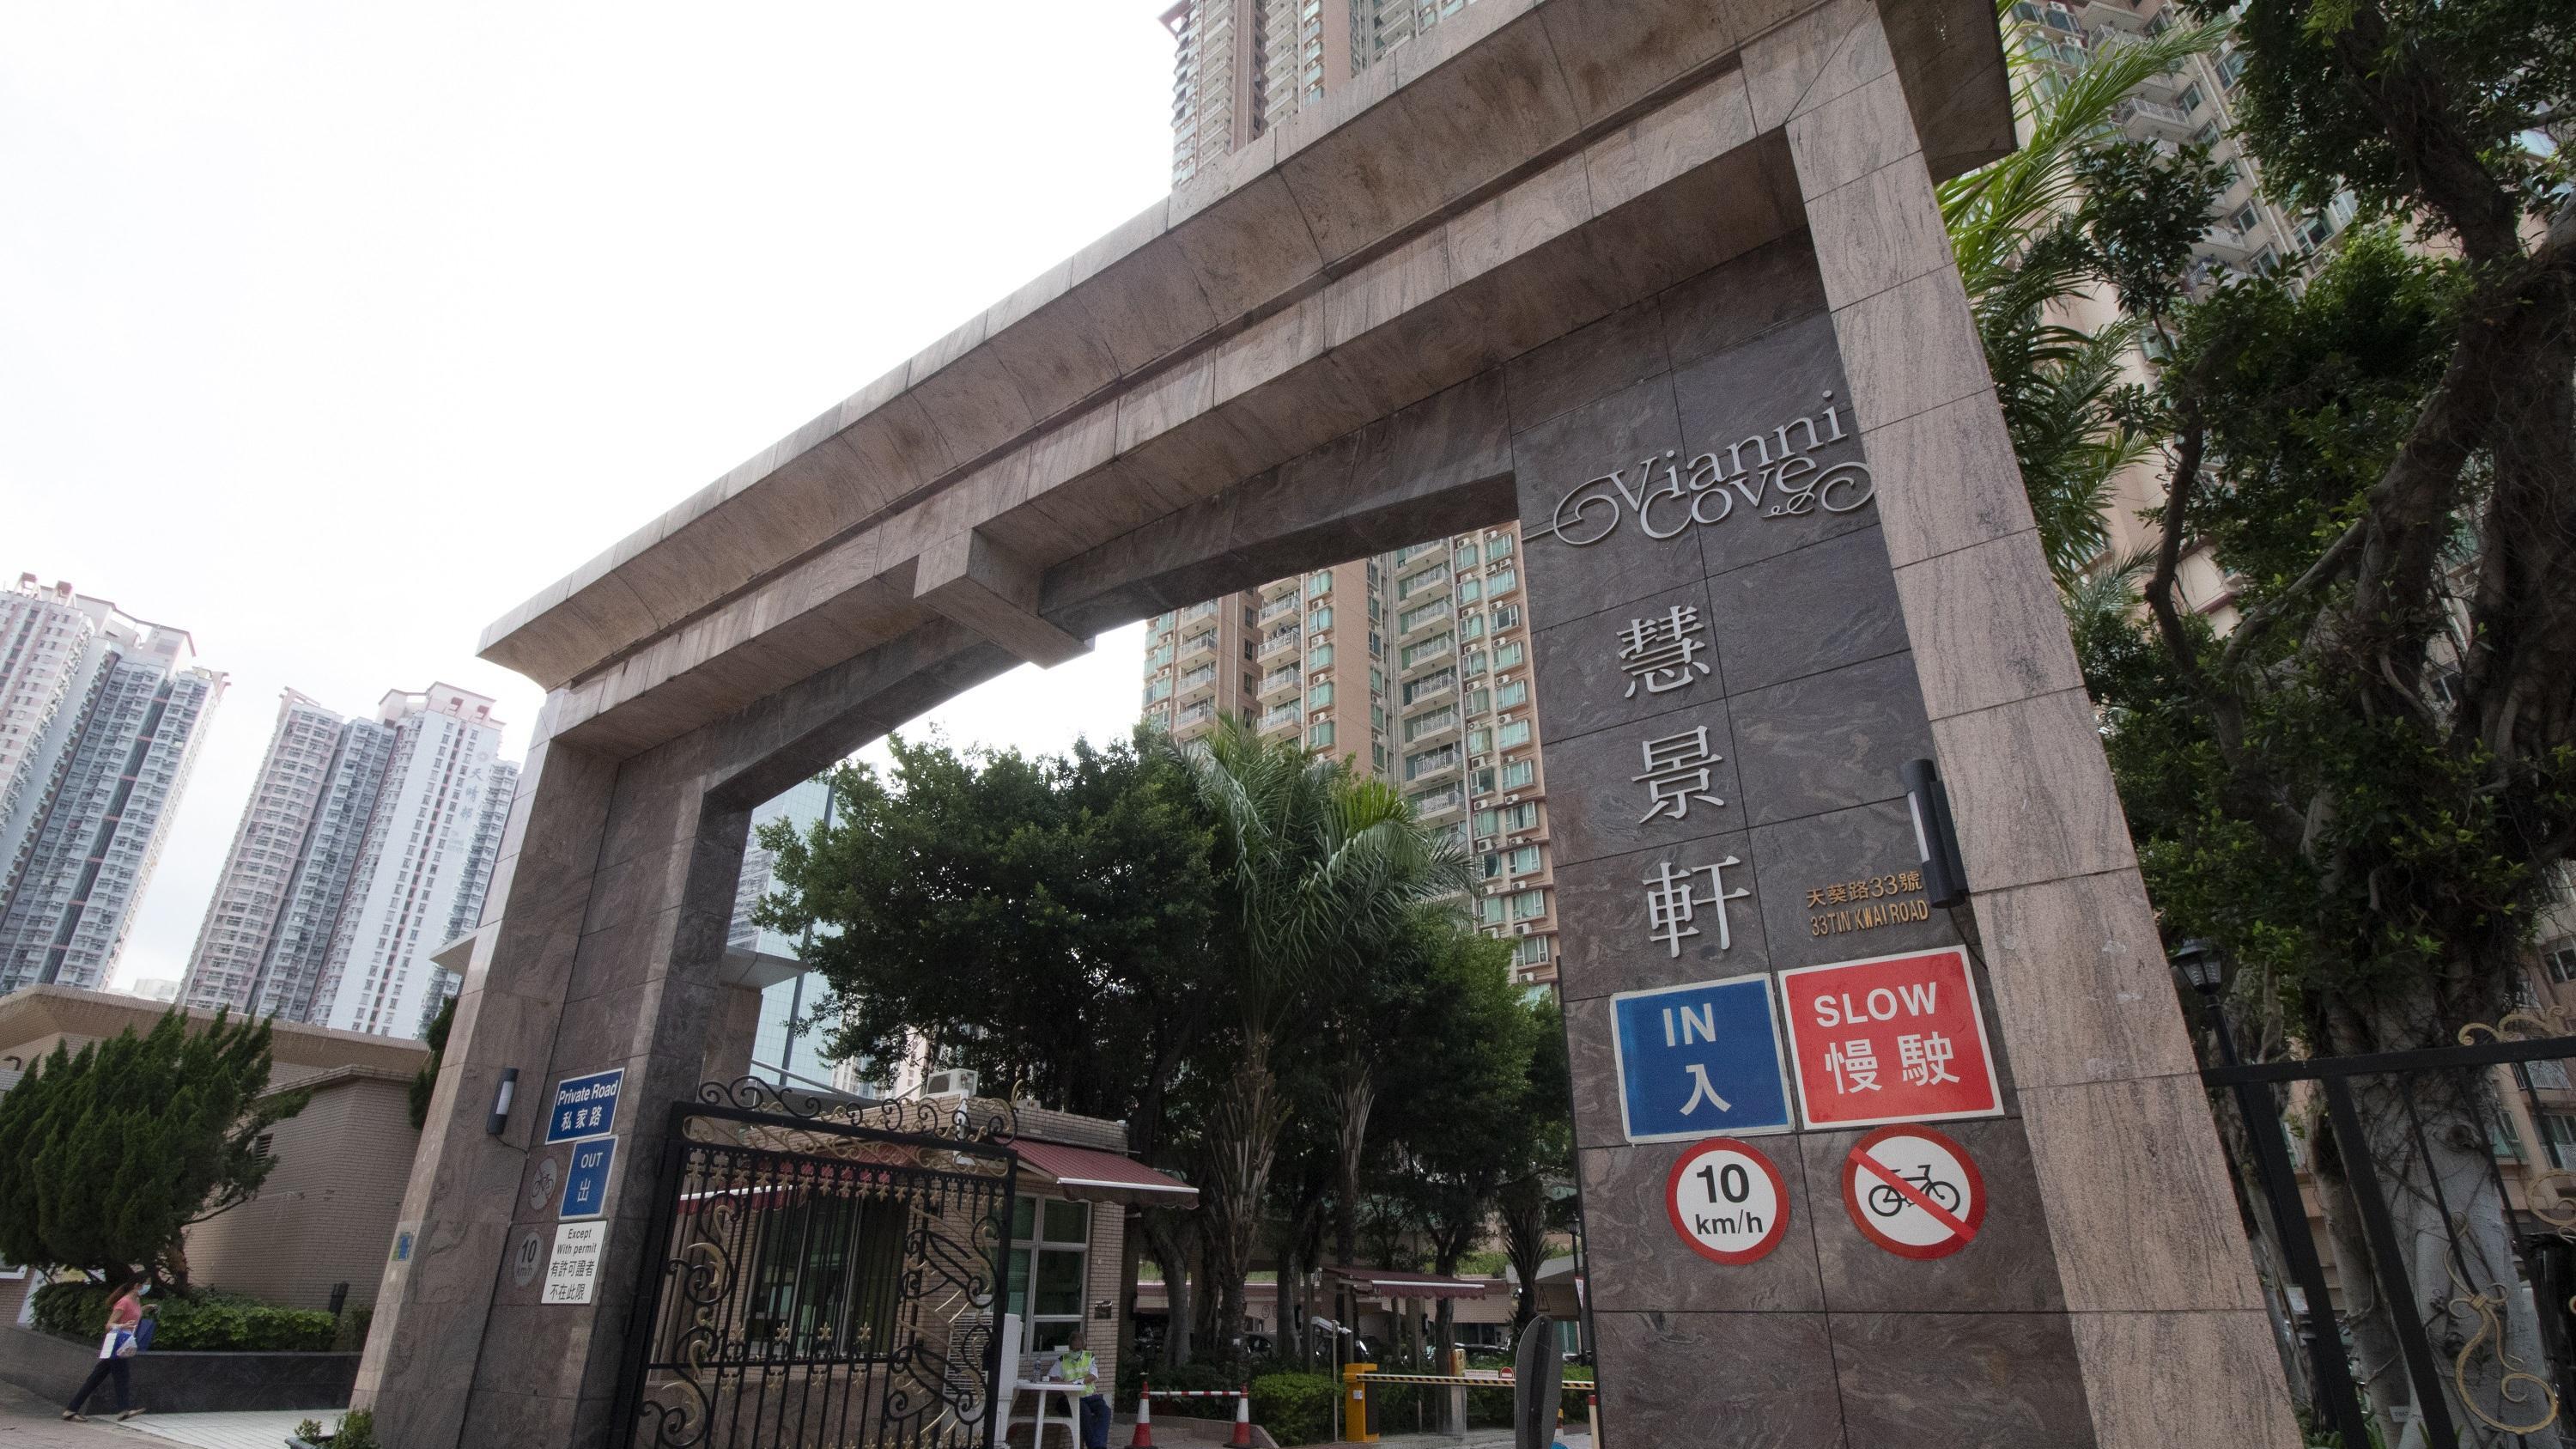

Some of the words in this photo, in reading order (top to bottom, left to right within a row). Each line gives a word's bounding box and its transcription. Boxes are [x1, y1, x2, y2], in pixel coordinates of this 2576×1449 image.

[1553, 390, 1848, 545] Vianni
[1640, 456, 1875, 539] Cove
[1616, 606, 1751, 959] 慧景軒
[1806, 870, 1923, 909] 天葵路33號
[1854, 904, 1888, 930] KWAI
[1889, 899, 1929, 925] ROAD
[1814, 981, 1937, 1028] SLOW
[1662, 1002, 1716, 1047] IN
[1824, 1031, 1960, 1095] 慢駛
[557, 1087, 591, 1106] Private
[591, 1079, 619, 1099] Road
[1679, 1063, 1732, 1116] 入
[561, 1105, 603, 1132] 私家路
[580, 1152, 603, 1169] OUT
[576, 1178, 591, 1202] 出
[1696, 1162, 1750, 1204] 10
[568, 1227, 592, 1241] Except
[1695, 1209, 1764, 1235] km/h
[521, 1239, 538, 1263] 10
[556, 1243, 573, 1255] With
[573, 1243, 598, 1257] permit
[550, 1258, 595, 1277] 有許可證者
[550, 1282, 586, 1300] 不在此限
